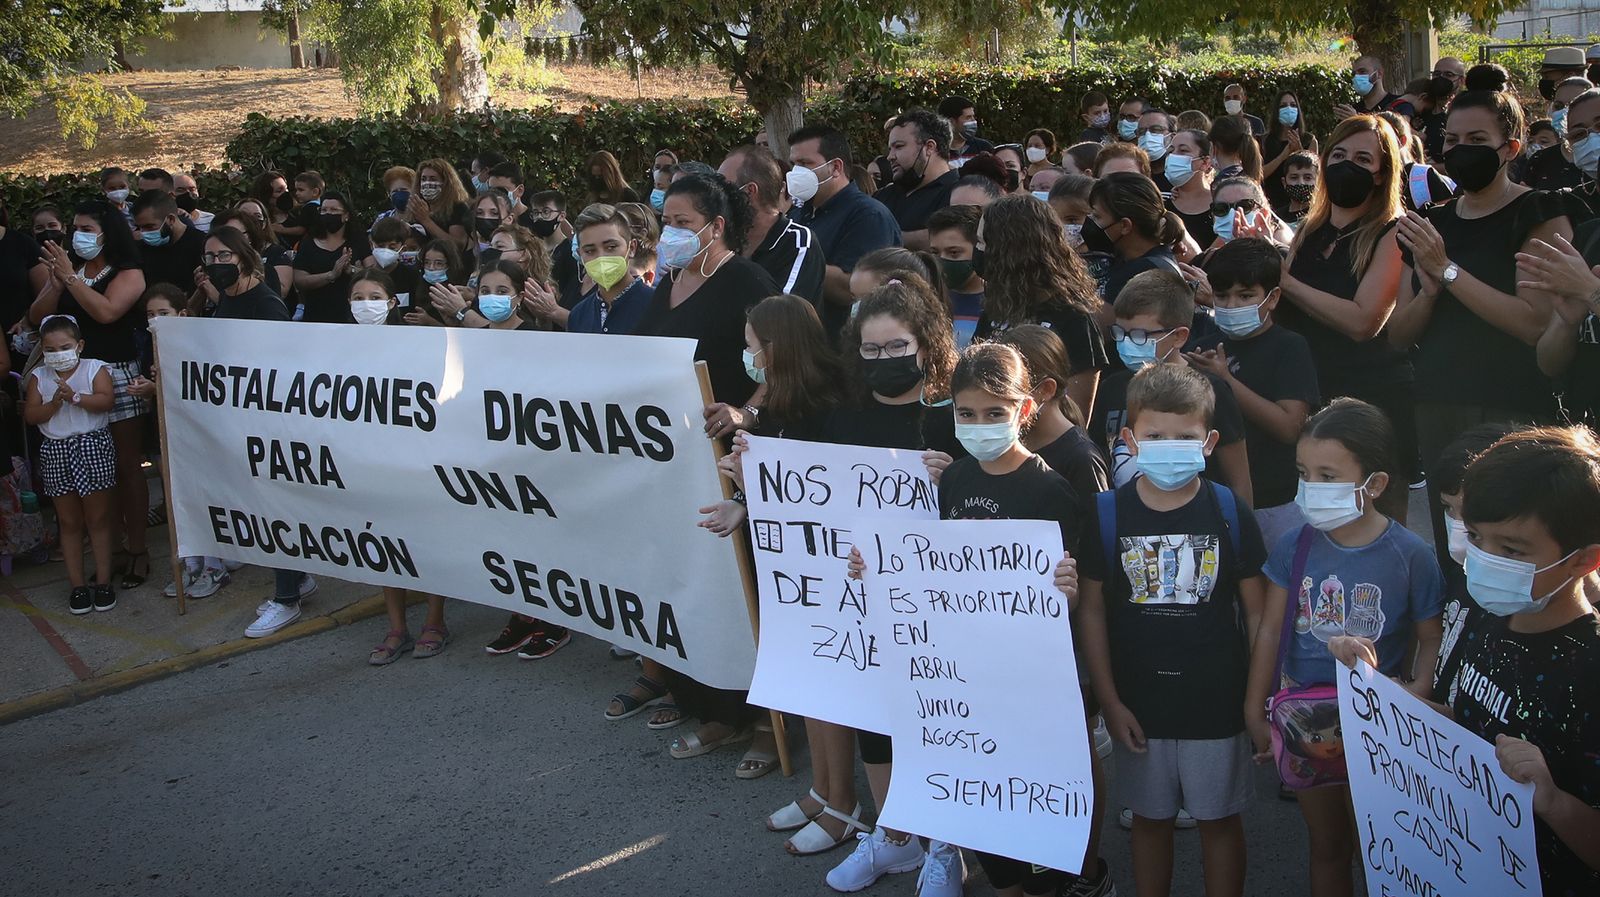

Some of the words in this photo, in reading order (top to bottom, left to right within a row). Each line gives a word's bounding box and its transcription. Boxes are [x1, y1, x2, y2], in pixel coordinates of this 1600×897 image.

[181, 360, 437, 433] INSTALACIONES
[483, 389, 675, 463] DIGNAS
[246, 435, 346, 490] PARA
[433, 464, 558, 519] UNA
[758, 460, 832, 506] NOS
[850, 463, 939, 513] ROBAN
[964, 496, 1000, 513] MAKES
[786, 521, 854, 560] TIE
[902, 533, 1050, 576] PRIORITARIO
[207, 505, 420, 579] EDUCACIÓN
[482, 550, 689, 661] SEGURA
[772, 570, 823, 607] DE
[889, 587, 918, 614] ES
[923, 585, 1061, 618] PRIORITARIO
[910, 656, 967, 684] ABRIL
[916, 690, 970, 719] JUNIO
[922, 726, 997, 755] AGOSTO
[1349, 669, 1388, 736] SR
[1389, 702, 1521, 829] DELEGADO
[1361, 731, 1482, 853] PROVINCIAL
[1497, 835, 1527, 890] DE
[1393, 810, 1467, 884] CADIZ
